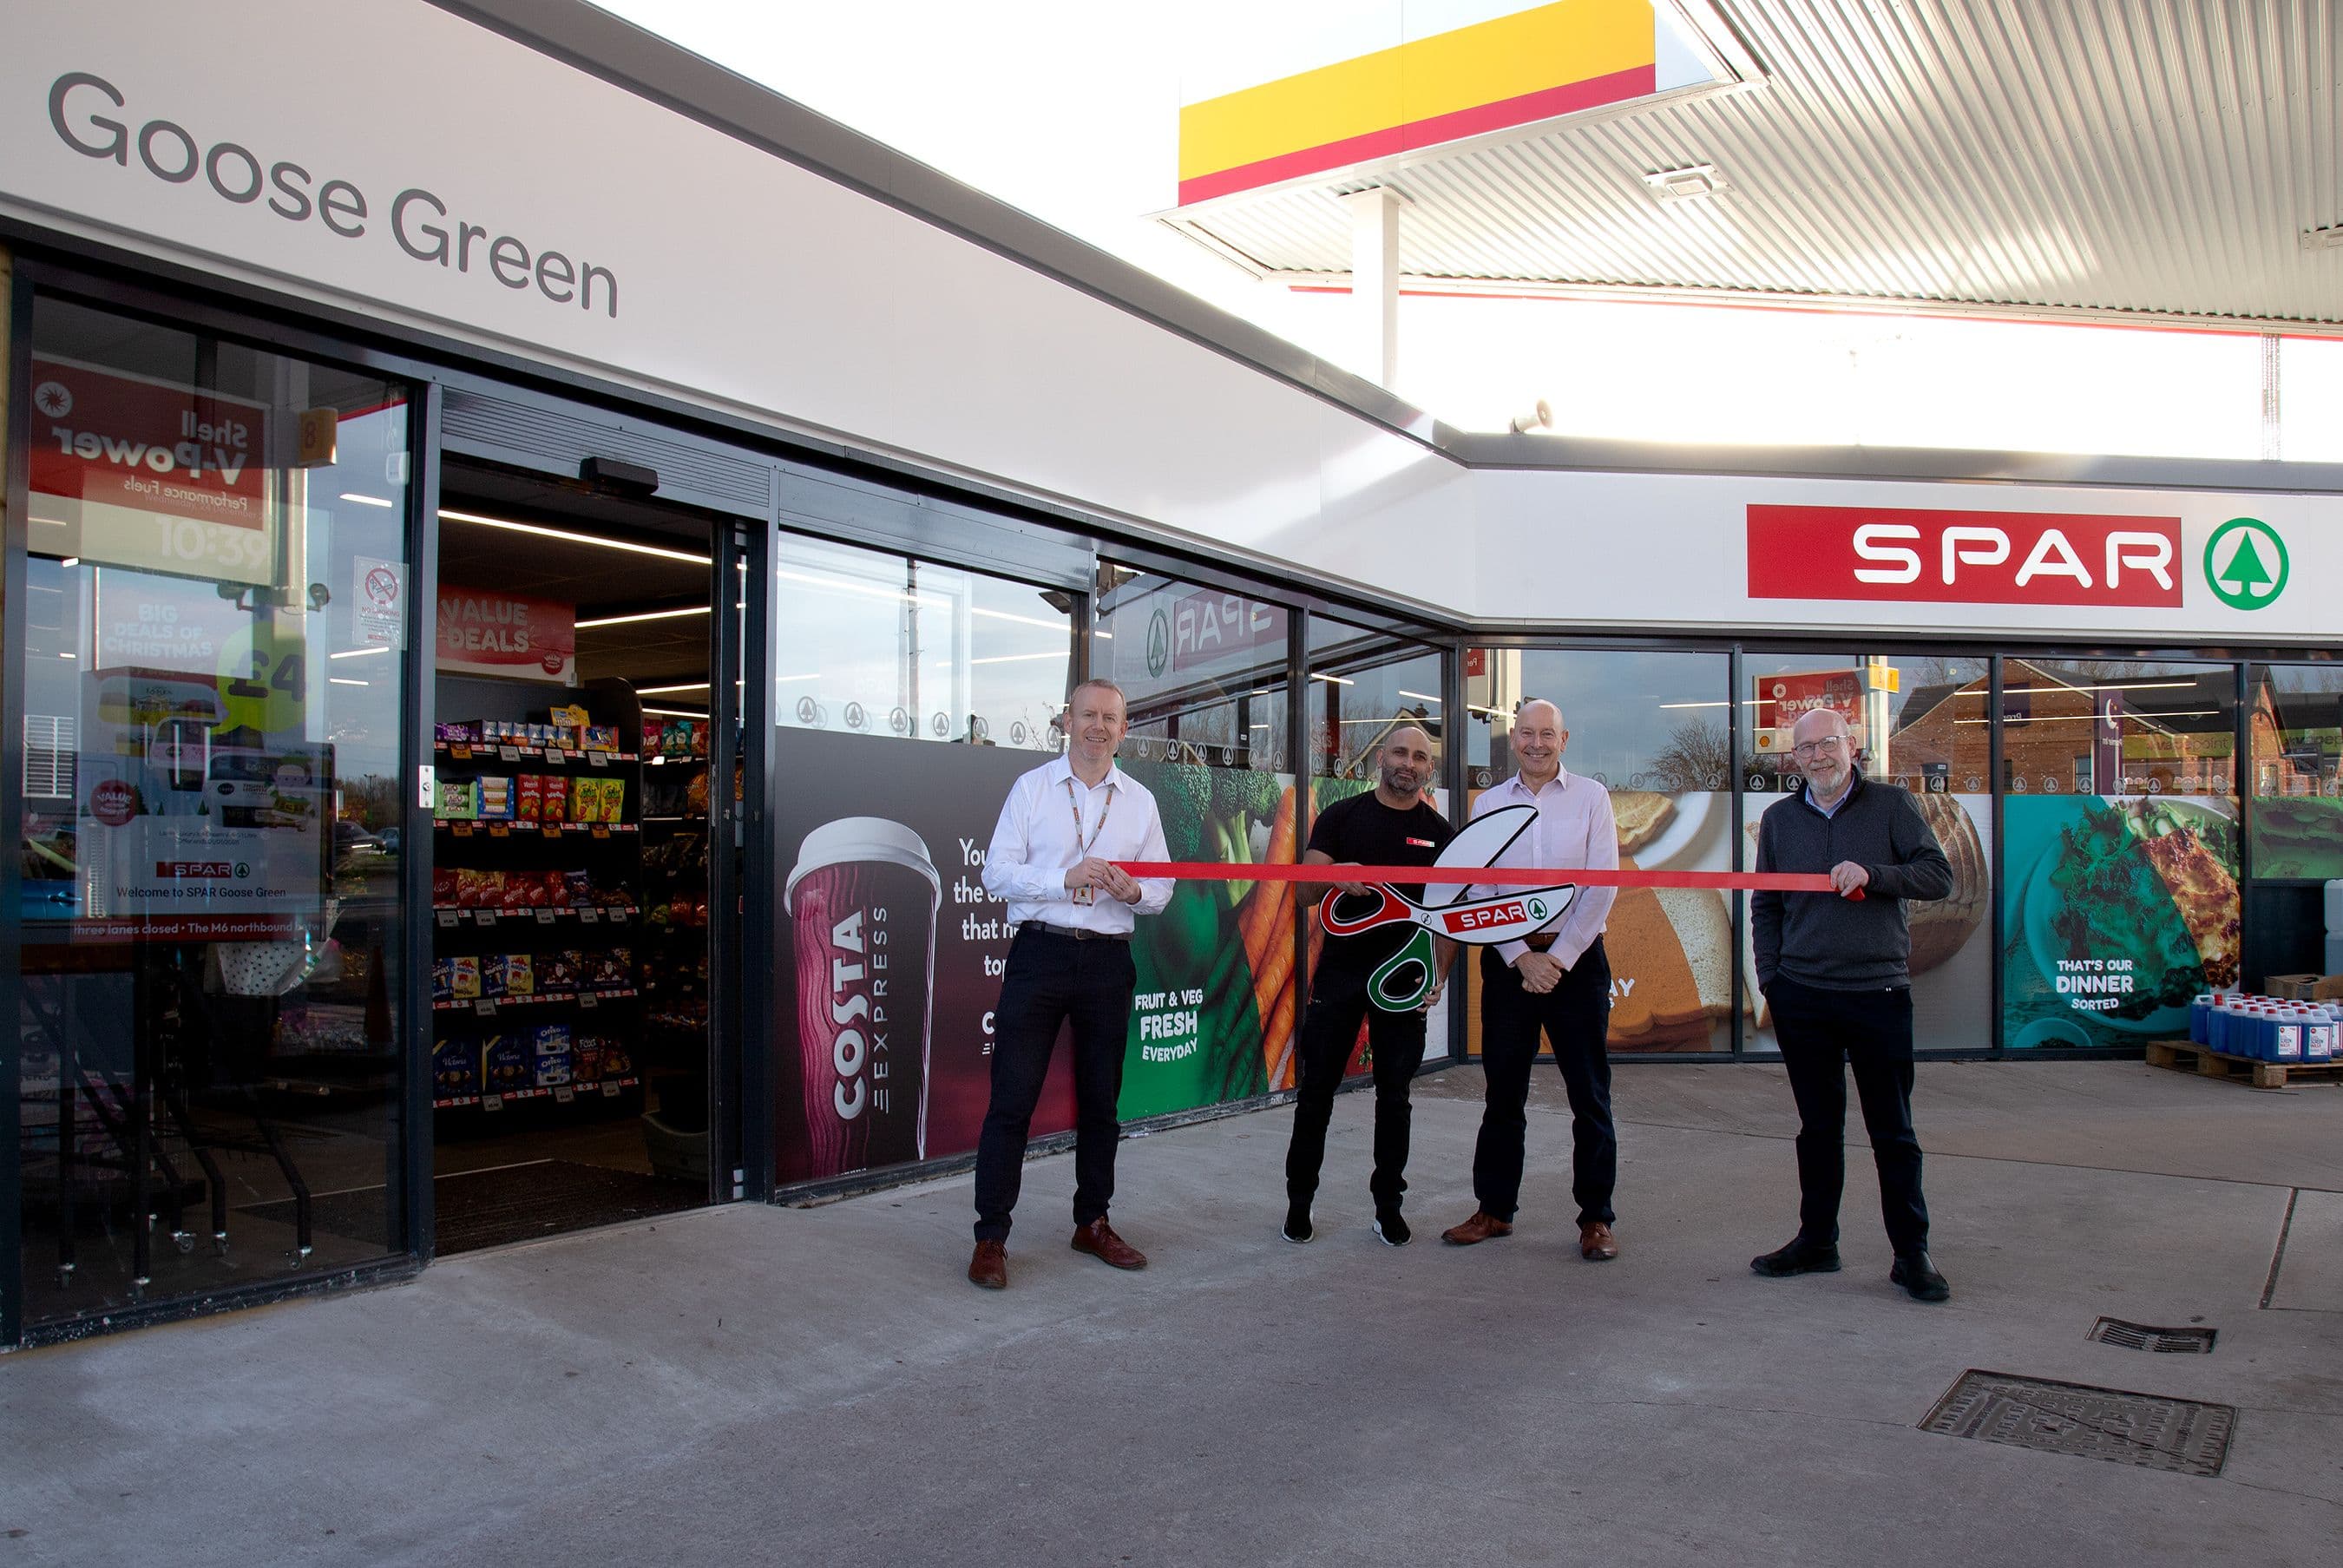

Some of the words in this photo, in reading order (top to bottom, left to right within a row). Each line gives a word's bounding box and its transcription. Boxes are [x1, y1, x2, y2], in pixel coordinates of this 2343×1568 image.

[48, 71, 368, 238] Goose
[390, 188, 619, 318] Green
[155, 515, 268, 569] 10:39
[1852, 523, 2173, 591] SPAR
[139, 603, 179, 623] BIG
[440, 598, 528, 626] VALUE
[114, 622, 174, 639] DEALS
[180, 627, 203, 640] OF
[446, 627, 529, 653] DEALS
[104, 638, 213, 659] CHRISTMAS
[174, 863, 230, 876] SPAR
[117, 886, 170, 898] Welcome
[173, 887, 184, 898] to
[187, 887, 216, 898] SPAR
[220, 887, 253, 898] Goose
[256, 887, 286, 897] Green
[954, 876, 983, 904] the
[75, 924, 105, 935] three
[108, 922, 139, 935] lanes
[141, 922, 179, 935] closed
[187, 922, 209, 934] The
[211, 922, 228, 933] M6
[230, 922, 293, 933] northbound
[962, 913, 999, 941] that
[1460, 905, 1526, 928] SPAR
[2057, 959, 2103, 972] THAT'S
[2107, 959, 2133, 971] OUR
[873, 906, 889, 1080] EXPRESS
[2055, 974, 2134, 994] DINNER
[1135, 992, 1165, 1012] FRUIT
[1168, 991, 1178, 1007] &
[1180, 987, 1204, 1006] VEG
[2071, 998, 2119, 1011] SORTED
[832, 909, 869, 1120] COSTA
[1140, 1010, 1198, 1041] FRESH
[1142, 1037, 1198, 1063] EVERYDAY
